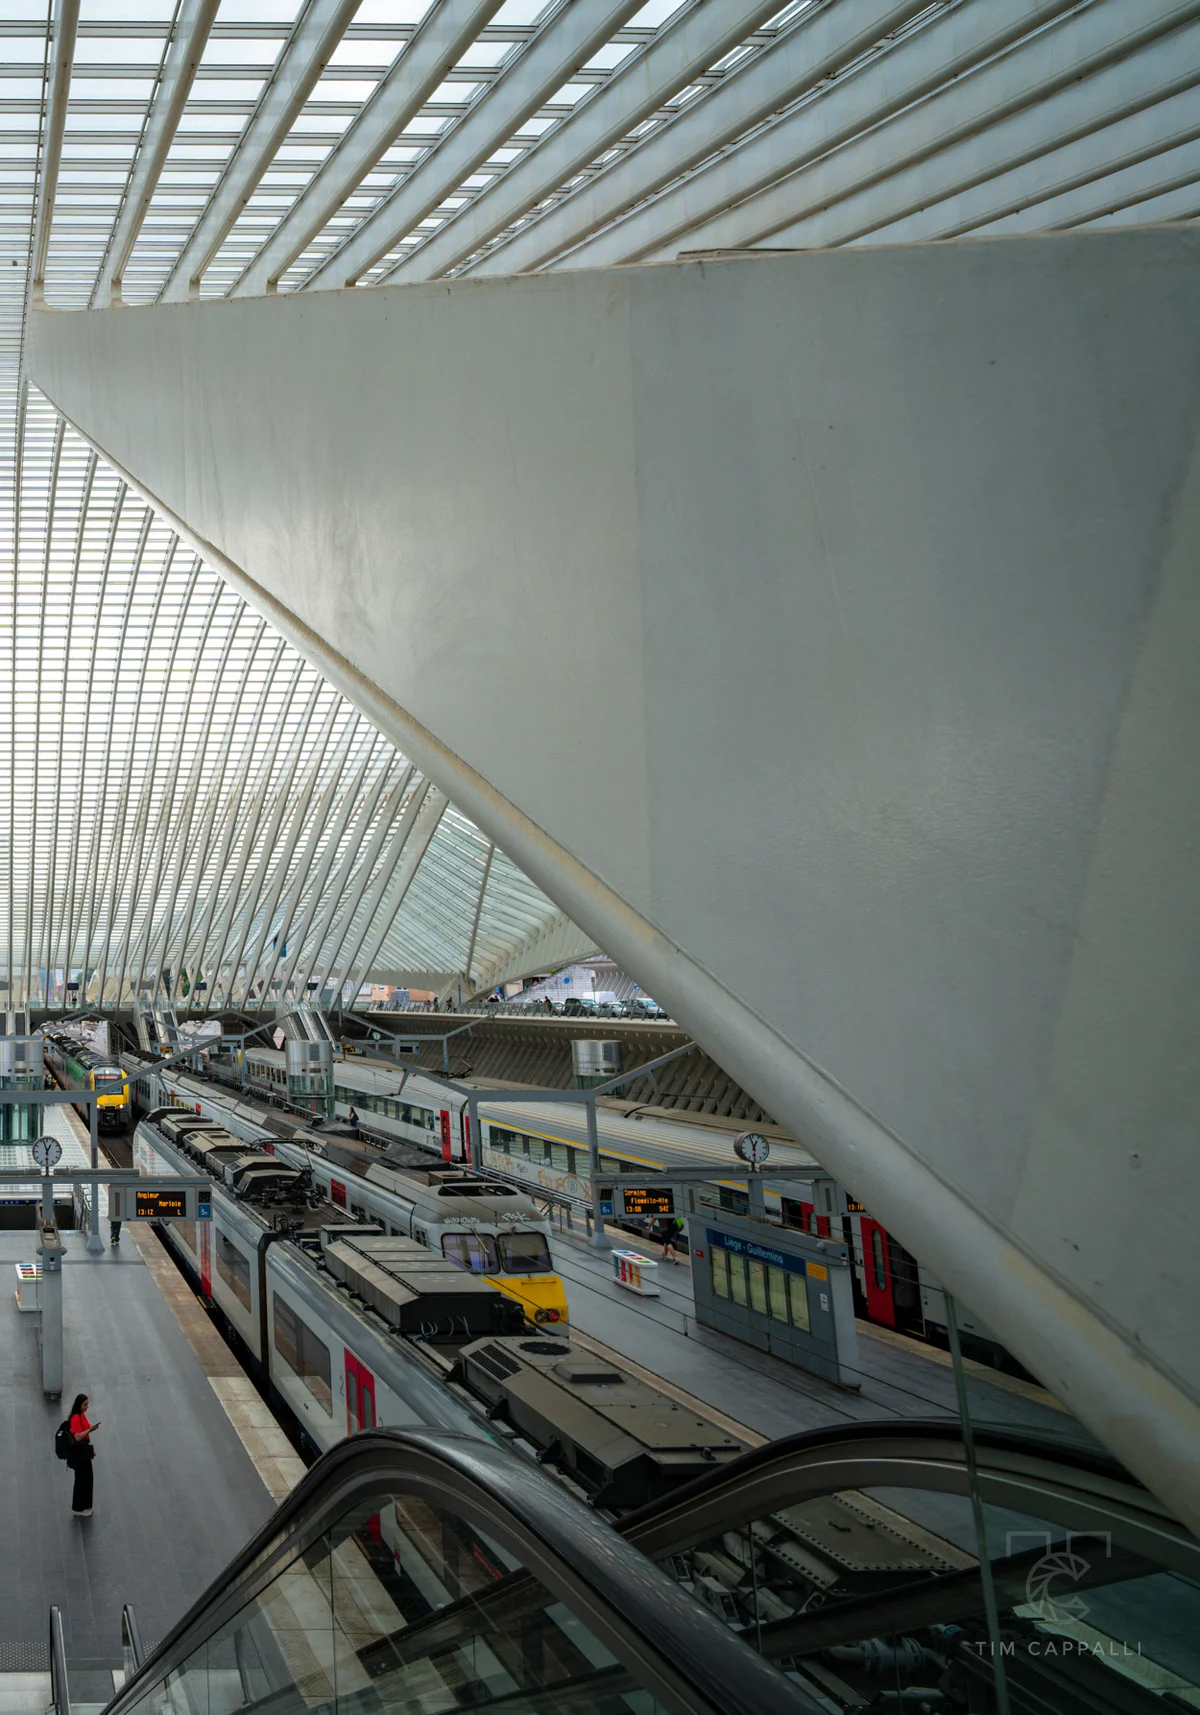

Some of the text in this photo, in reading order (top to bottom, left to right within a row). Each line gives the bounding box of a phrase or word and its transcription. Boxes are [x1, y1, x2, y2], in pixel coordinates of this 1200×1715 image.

[138, 1208, 154, 1216] 13:12
[724, 1235, 742, 1251] Liège
[747, 1243, 784, 1264] Guillemins
